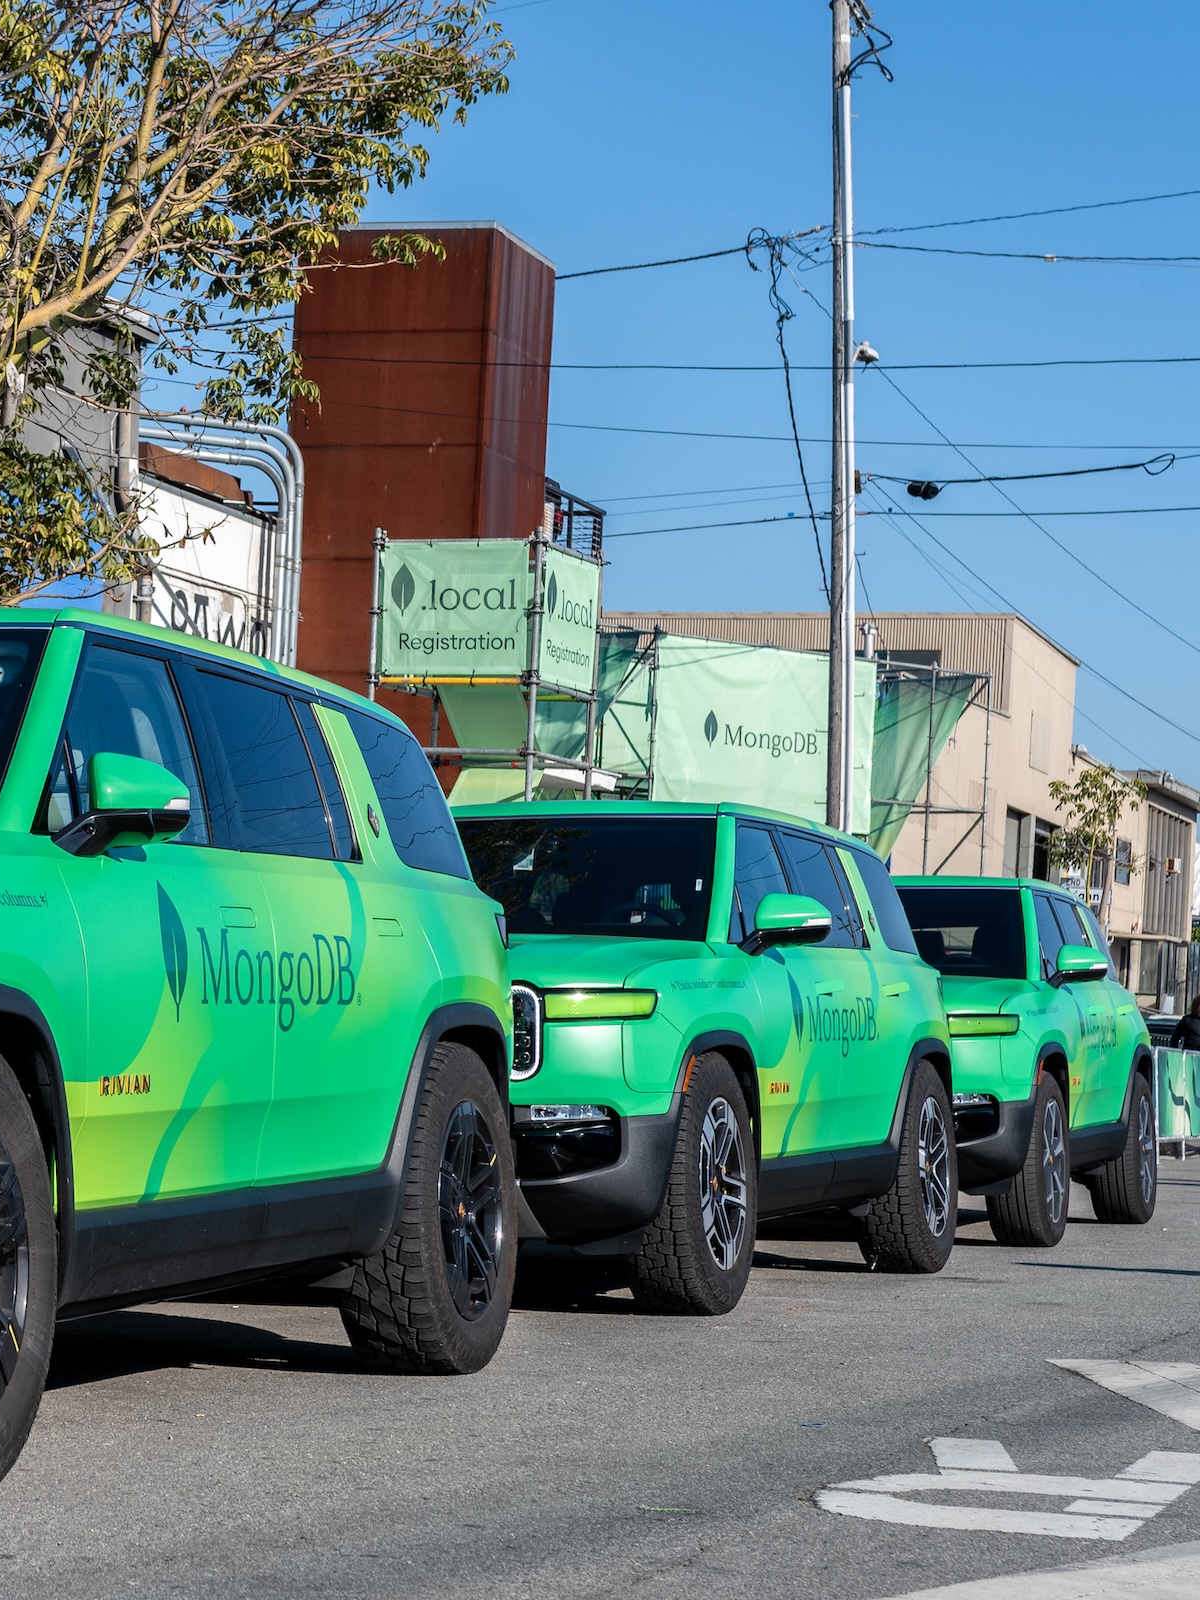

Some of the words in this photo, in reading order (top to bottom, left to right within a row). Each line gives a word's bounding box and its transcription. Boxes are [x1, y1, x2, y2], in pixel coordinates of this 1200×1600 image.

[421, 578, 516, 611] .local
[557, 590, 593, 629] .local
[399, 632, 515, 655] Registration
[546, 639, 590, 668] Registration
[724, 724, 818, 758] MongoDB
[196, 927, 355, 1032] MongoDB
[806, 996, 876, 1058] MongoDB
[99, 1074, 150, 1096] RIVIAN
